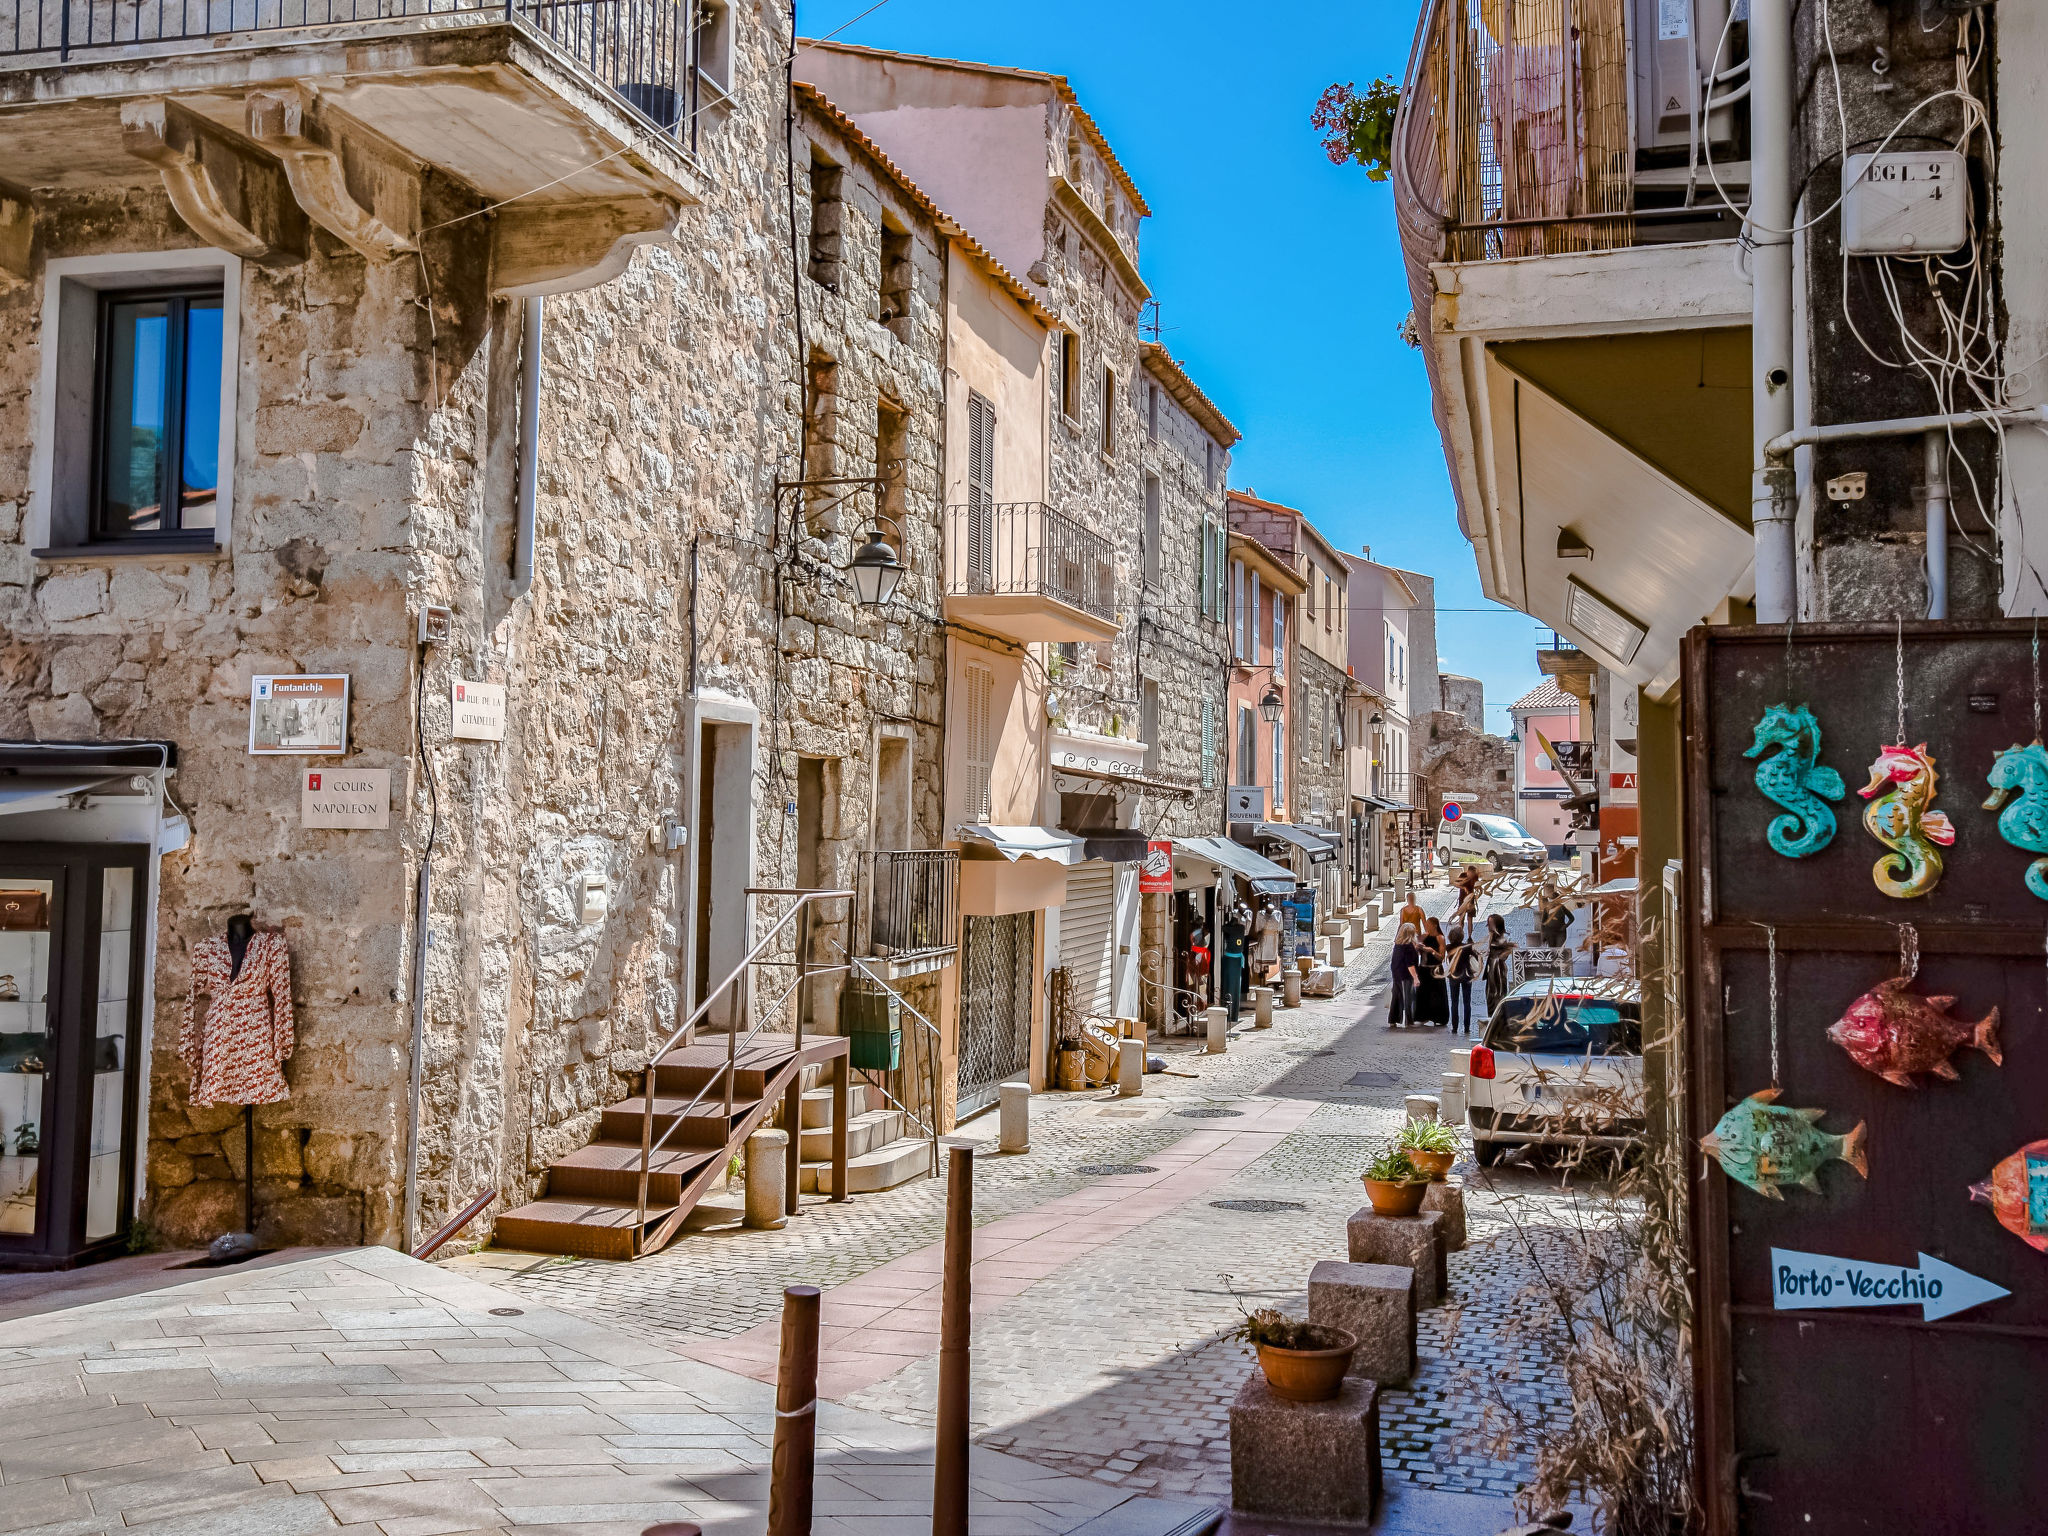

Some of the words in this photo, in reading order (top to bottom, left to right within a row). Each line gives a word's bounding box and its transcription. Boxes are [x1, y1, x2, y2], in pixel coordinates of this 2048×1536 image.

[1929, 185, 1942, 200] 4
[273, 683, 323, 694] Funtanichja
[466, 695, 479, 705] RUE
[481, 696, 491, 706] DE
[492, 697, 501, 707] LA
[461, 714, 497, 727] CITADELLE
[333, 781, 374, 792] COURS
[312, 803, 377, 815] NAPOLEON
[1778, 1265, 1943, 1299] Porto-Vecchio
